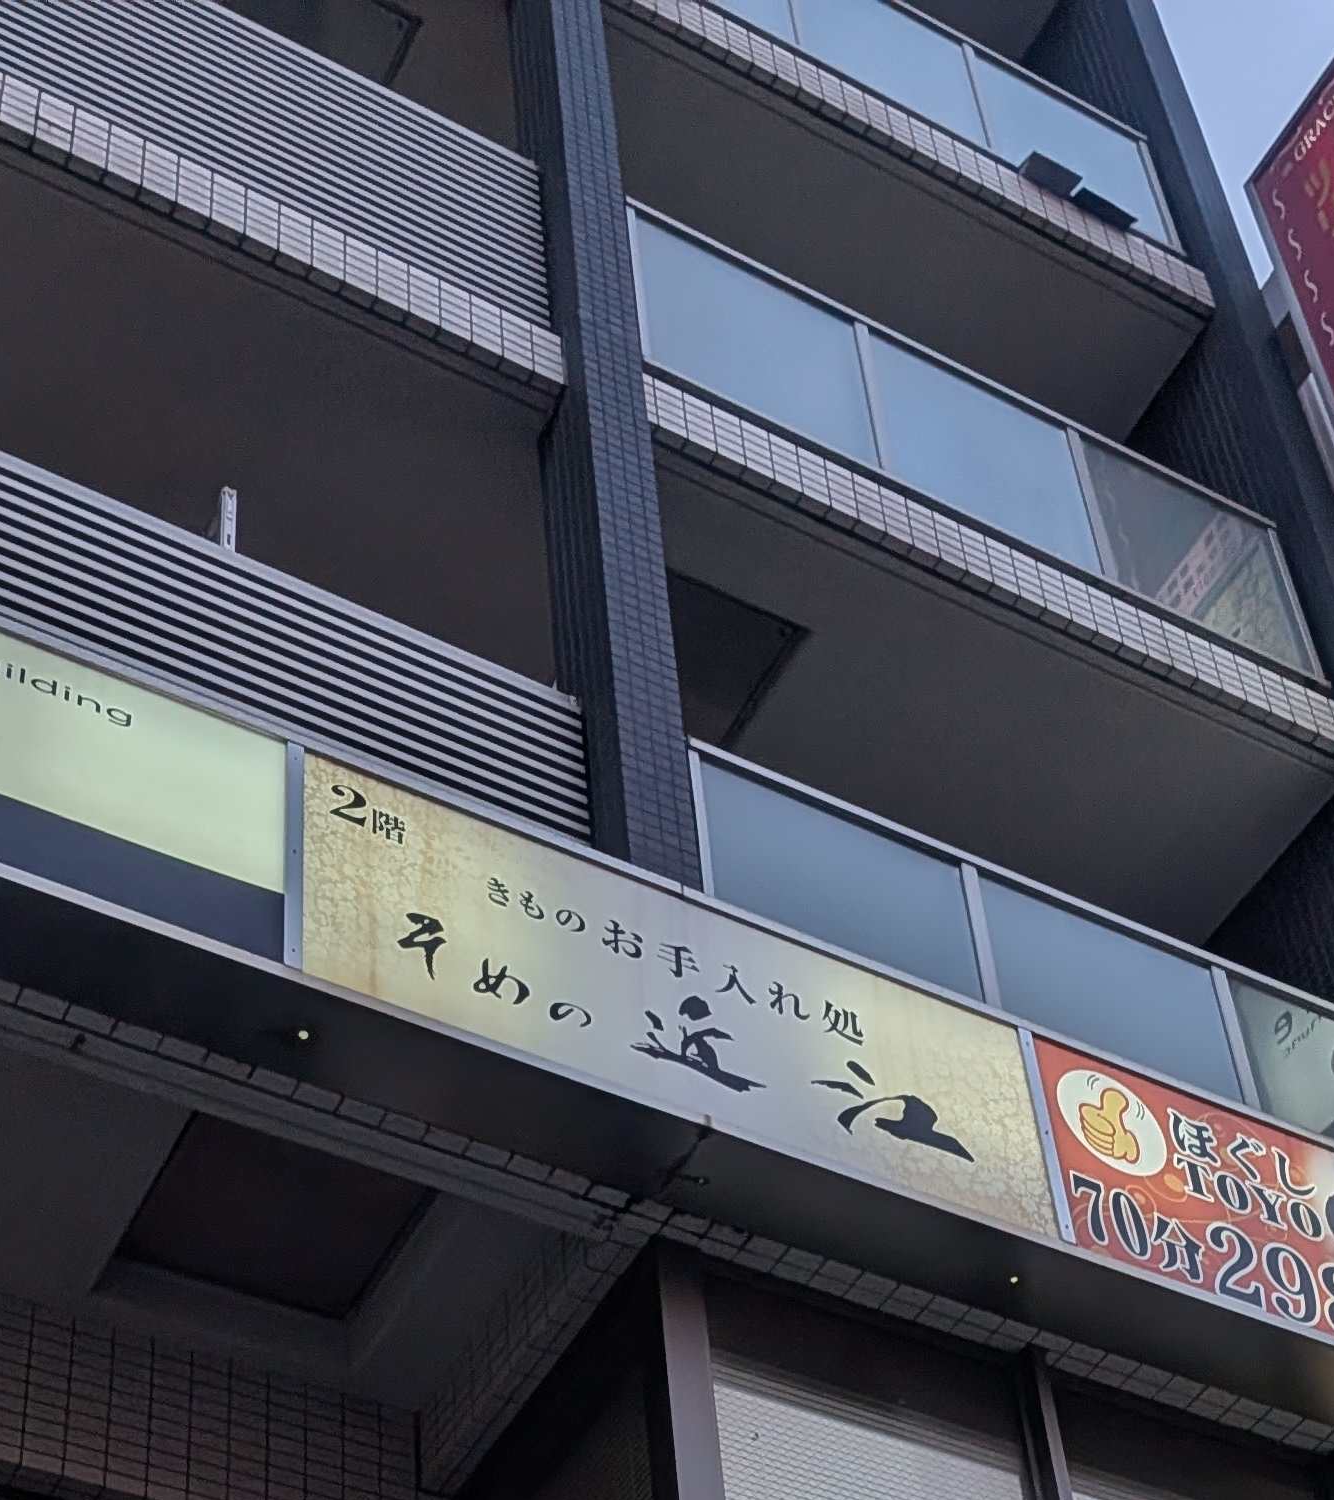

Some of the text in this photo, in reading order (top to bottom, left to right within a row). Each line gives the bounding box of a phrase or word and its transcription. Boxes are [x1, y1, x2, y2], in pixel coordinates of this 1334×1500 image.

[328, 783, 408, 847] 2階
[486, 877, 866, 1048] きものお手入れ処
[397, 912, 975, 1164] そめの近江
[1169, 1107, 1317, 1197] ほぐし
[1173, 1155, 1327, 1244] TOYO
